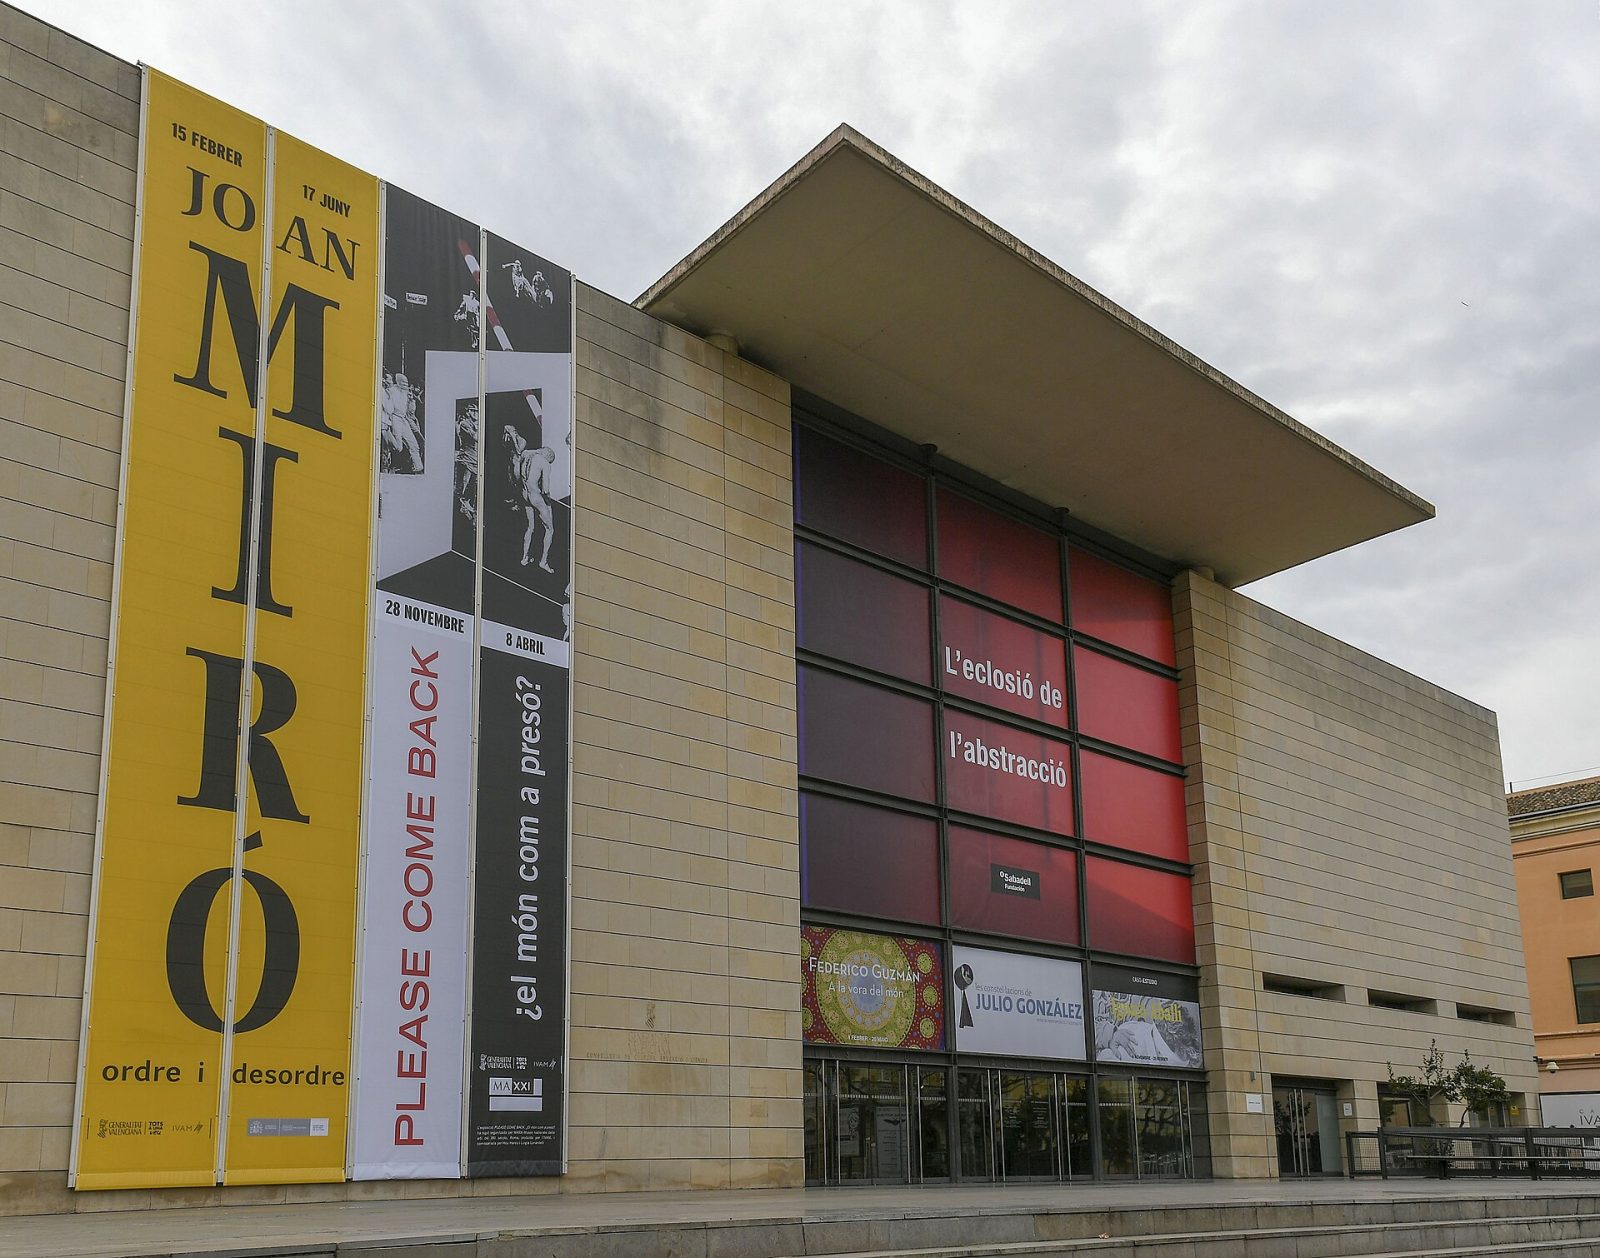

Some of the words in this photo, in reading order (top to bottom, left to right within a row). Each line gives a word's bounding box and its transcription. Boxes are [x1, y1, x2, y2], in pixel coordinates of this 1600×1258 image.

[171, 122, 187, 142] 15
[191, 132, 243, 168] FEBRER
[181, 166, 361, 281] JOAN
[301, 184, 316, 203] 17
[319, 193, 352, 218] JUNY
[165, 240, 343, 1034] MIRÓ
[384, 599, 401, 618] 28
[403, 604, 465, 635] NOVEMBRE
[505, 632, 513, 647] 8
[515, 635, 546, 656] ABRIL
[945, 646, 1034, 700] L’eclosió
[1040, 680, 1063, 709] de
[407, 645, 440, 779] BACK
[514, 674, 546, 777] presó?
[950, 730, 1068, 788] l’abstracció
[519, 786, 539, 805] a
[402, 792, 436, 933] COME
[518, 815, 539, 882] com
[1004, 872, 1032, 887] Sabadell
[511, 893, 538, 963] món
[510, 974, 544, 1022] ¿el
[828, 982, 836, 992] A
[838, 981, 846, 993] la
[848, 985, 868, 995] vora
[869, 985, 884, 997] del
[885, 987, 904, 998] món
[976, 993, 1013, 1013] JULIO
[1016, 997, 1083, 1020] GONZÁLEZ
[102, 1060, 181, 1083] ordre
[198, 1061, 205, 1083] i
[232, 1063, 346, 1086] desordre
[394, 948, 431, 1146] PLEASE
